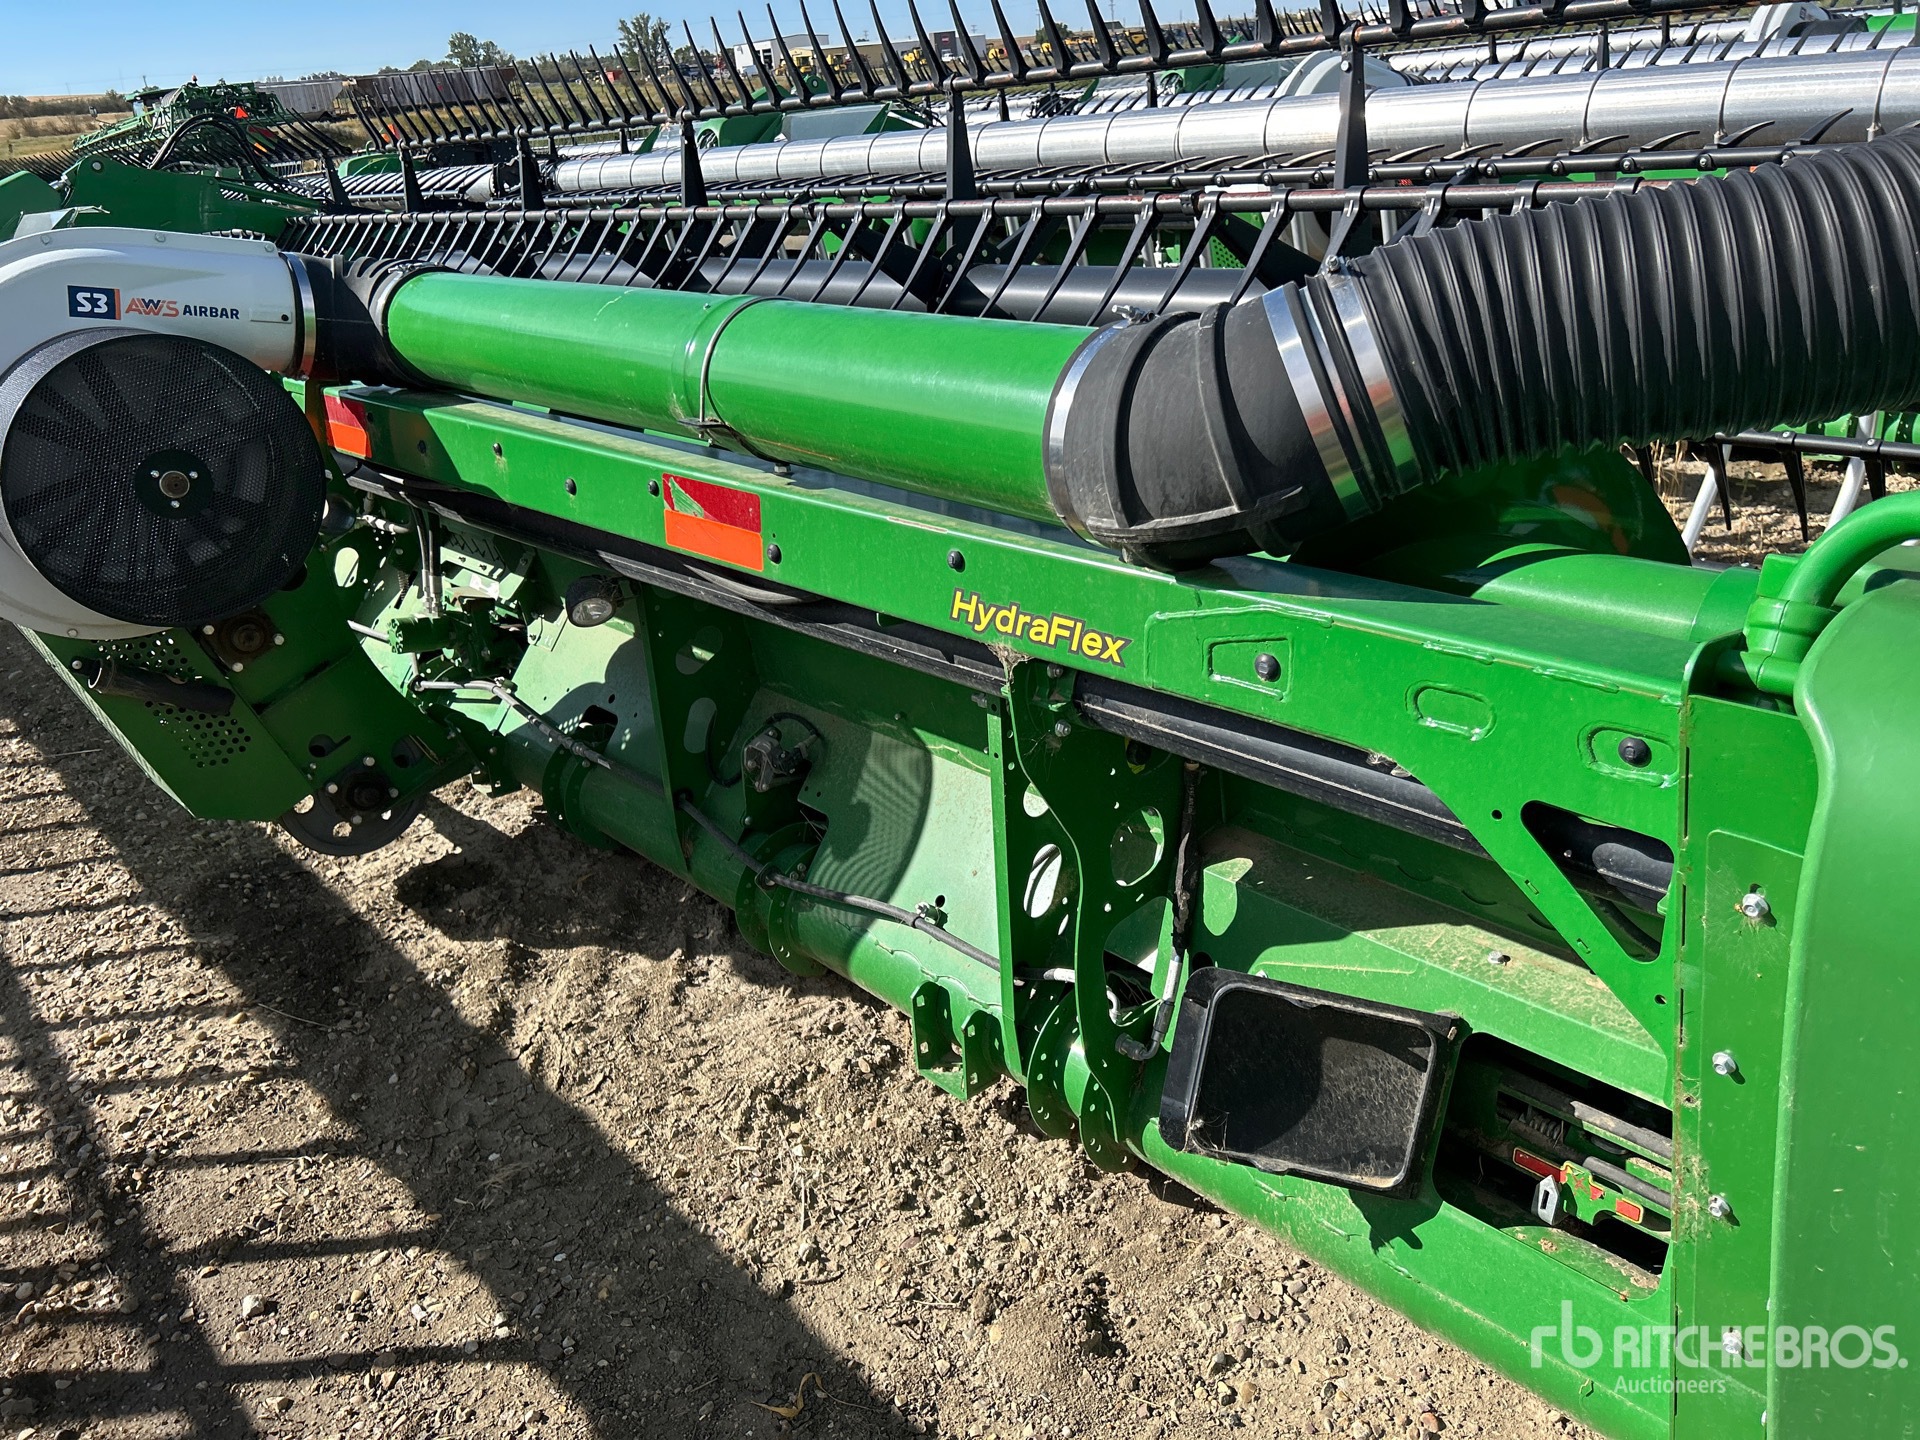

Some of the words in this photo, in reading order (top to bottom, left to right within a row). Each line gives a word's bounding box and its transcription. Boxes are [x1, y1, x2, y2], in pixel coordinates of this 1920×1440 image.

[75, 292, 108, 314] S3
[125, 297, 180, 317] AWS
[182, 304, 240, 320] AIRBAR
[951, 589, 1130, 666] HydraFlex
